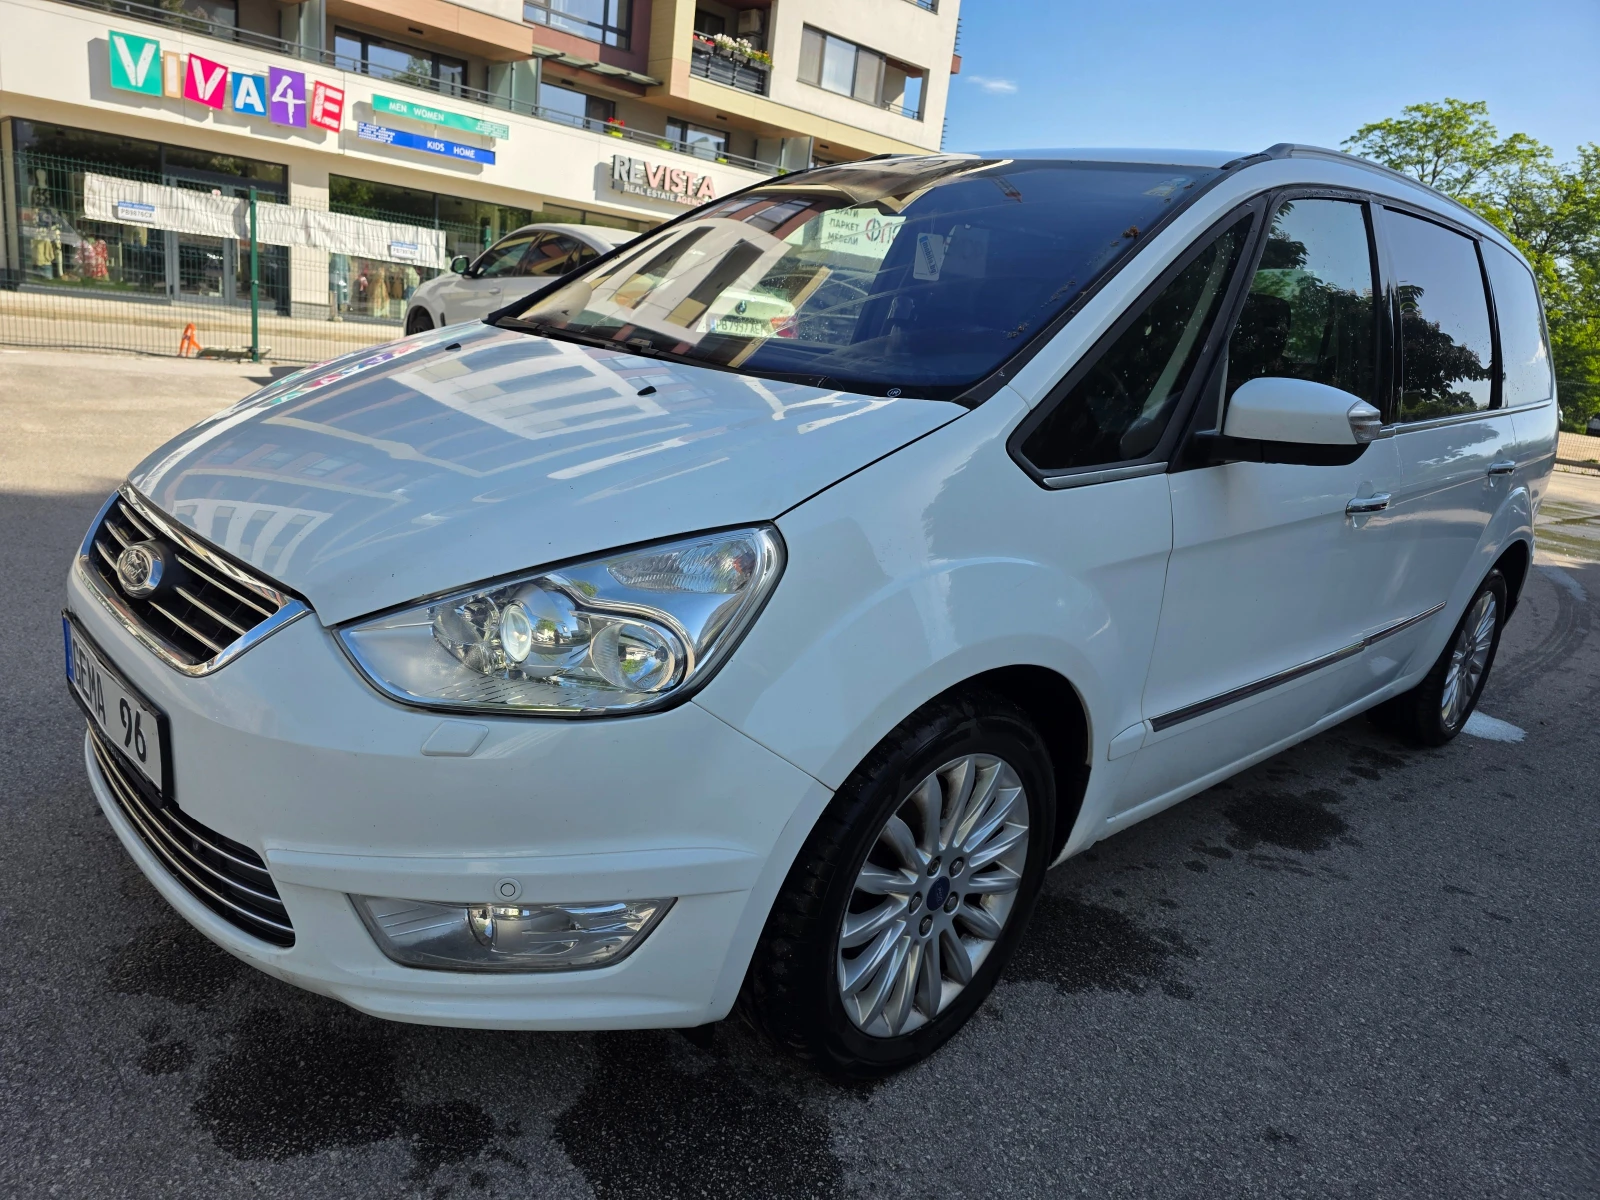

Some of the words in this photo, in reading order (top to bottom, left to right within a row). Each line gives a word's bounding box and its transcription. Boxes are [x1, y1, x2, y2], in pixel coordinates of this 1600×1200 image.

[388, 102, 407, 113] MEN
[413, 107, 445, 121] WOMEN
[427, 140, 445, 151] KIDS
[453, 146, 475, 158] HOME
[613, 155, 716, 199] REVISTA
[624, 182, 645, 195] REAL
[646, 190, 675, 201] ESTATE
[829, 218, 860, 232] ПАРКЕТ
[119, 697, 147, 764] 96
